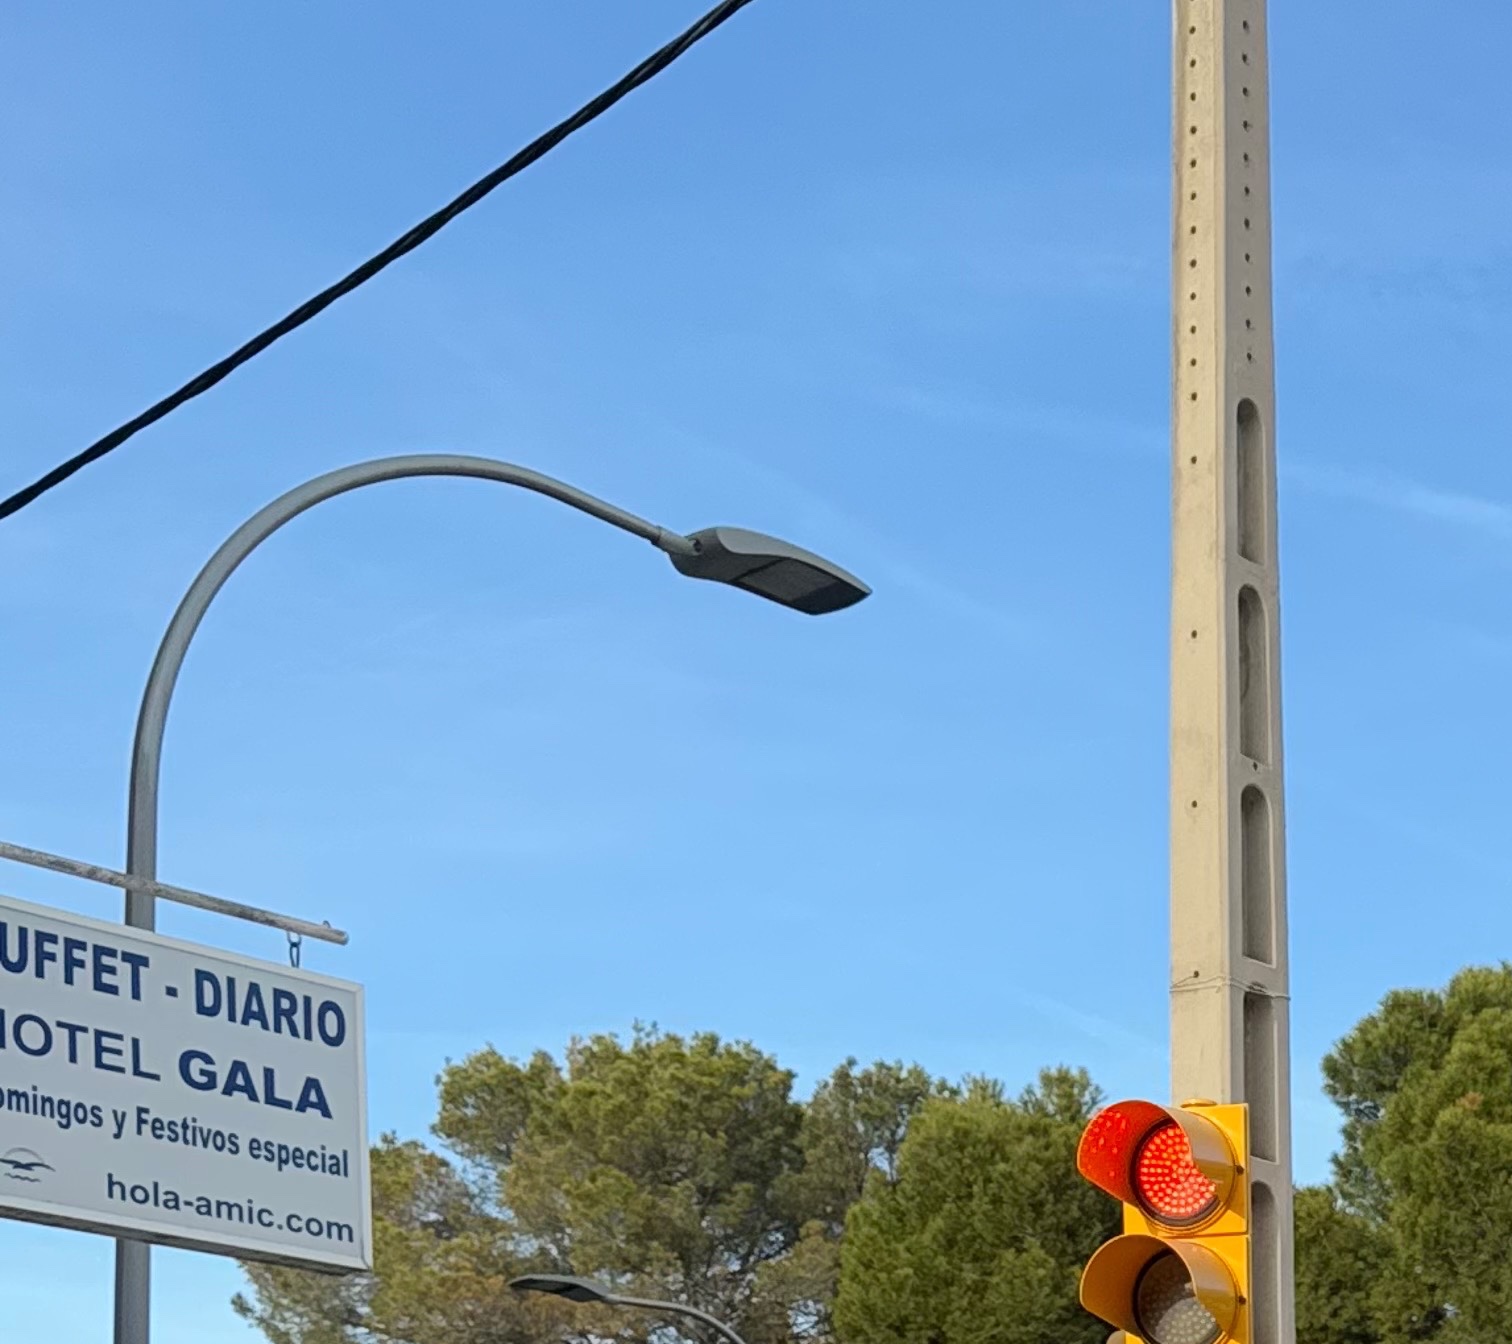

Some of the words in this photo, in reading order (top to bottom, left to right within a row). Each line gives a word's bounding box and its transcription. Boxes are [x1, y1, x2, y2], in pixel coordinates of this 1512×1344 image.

[194, 968, 346, 1048] DIARIO
[0, 1008, 161, 1082] OTEL
[178, 1049, 333, 1120] GALA
[112, 1109, 127, 1140] y
[135, 1106, 240, 1156] Festivos
[248, 1137, 349, 1178] especial
[107, 1172, 354, 1243] hola-amic.com
